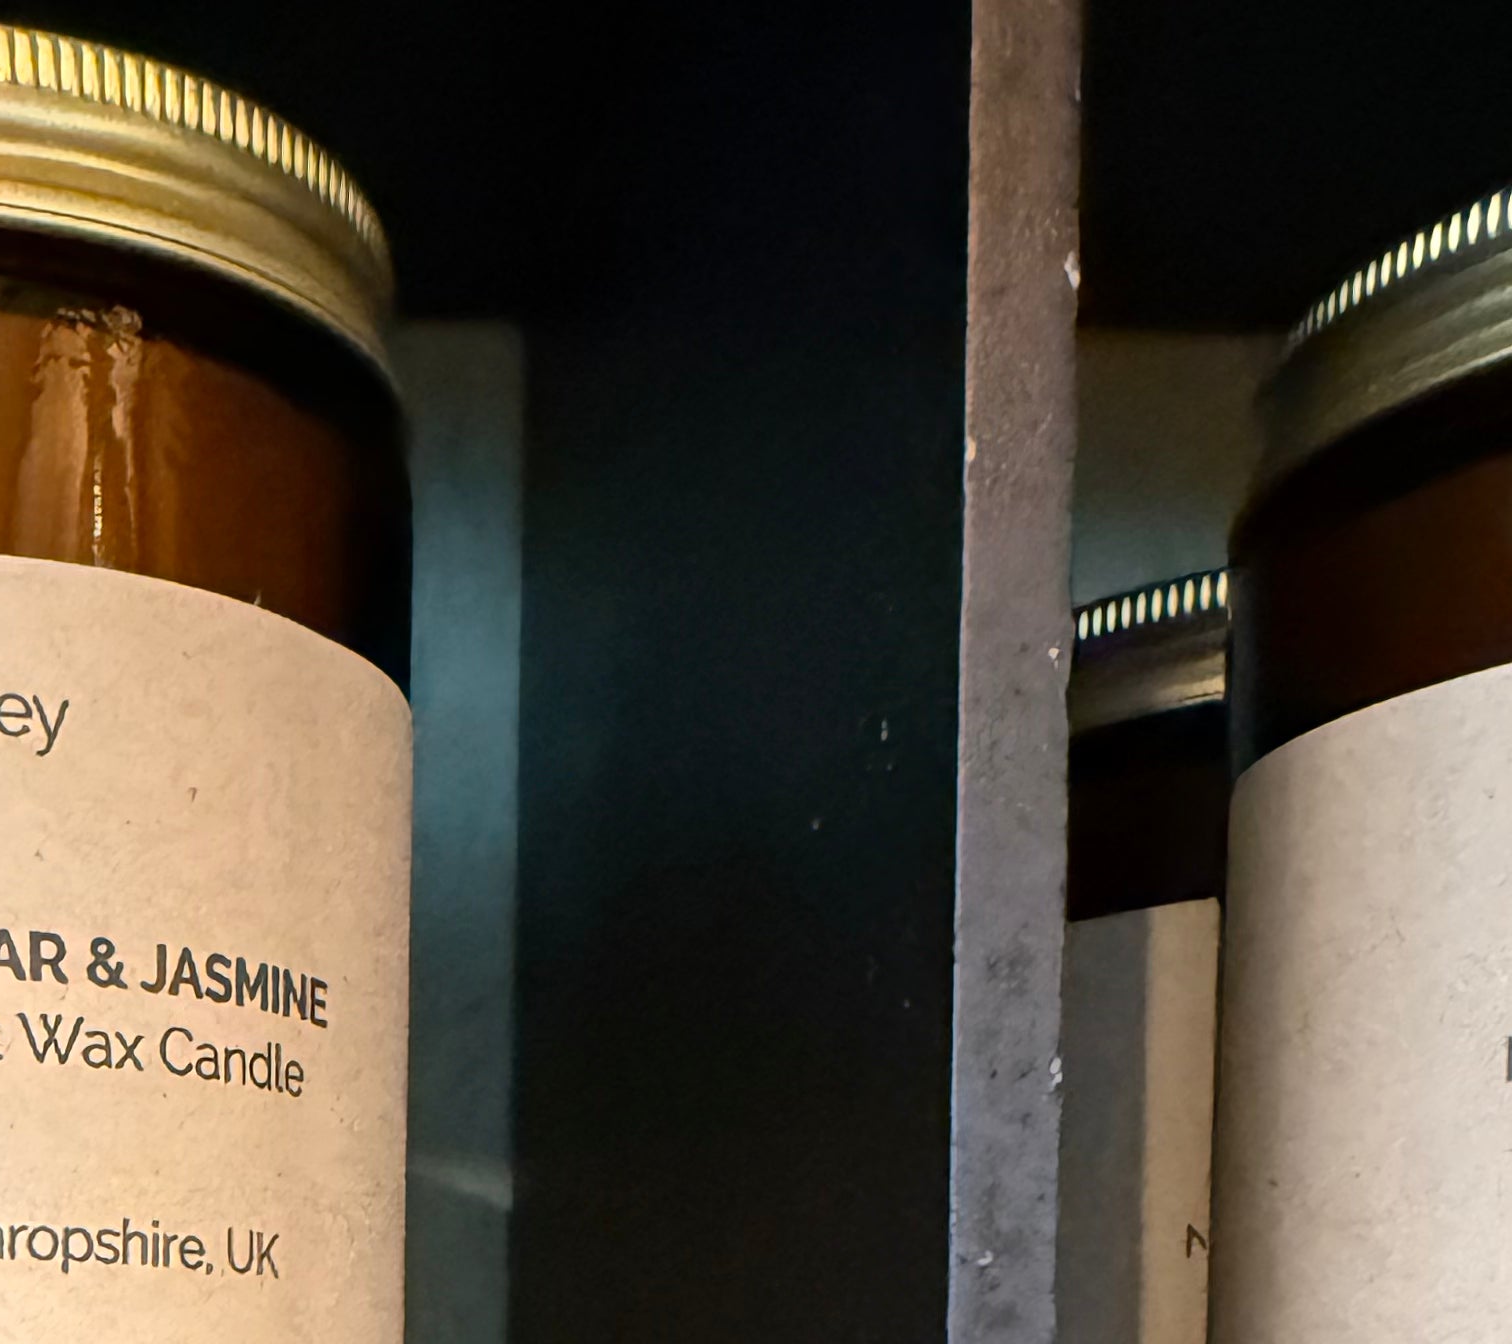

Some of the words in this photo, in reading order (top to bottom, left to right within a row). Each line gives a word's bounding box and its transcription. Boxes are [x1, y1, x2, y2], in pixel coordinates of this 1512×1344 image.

[87, 937, 128, 990] &
[140, 944, 328, 1028] JASMINE
[17, 1013, 145, 1071] Wax
[160, 1027, 304, 1097] Candle
[227, 1227, 280, 1279] UK
